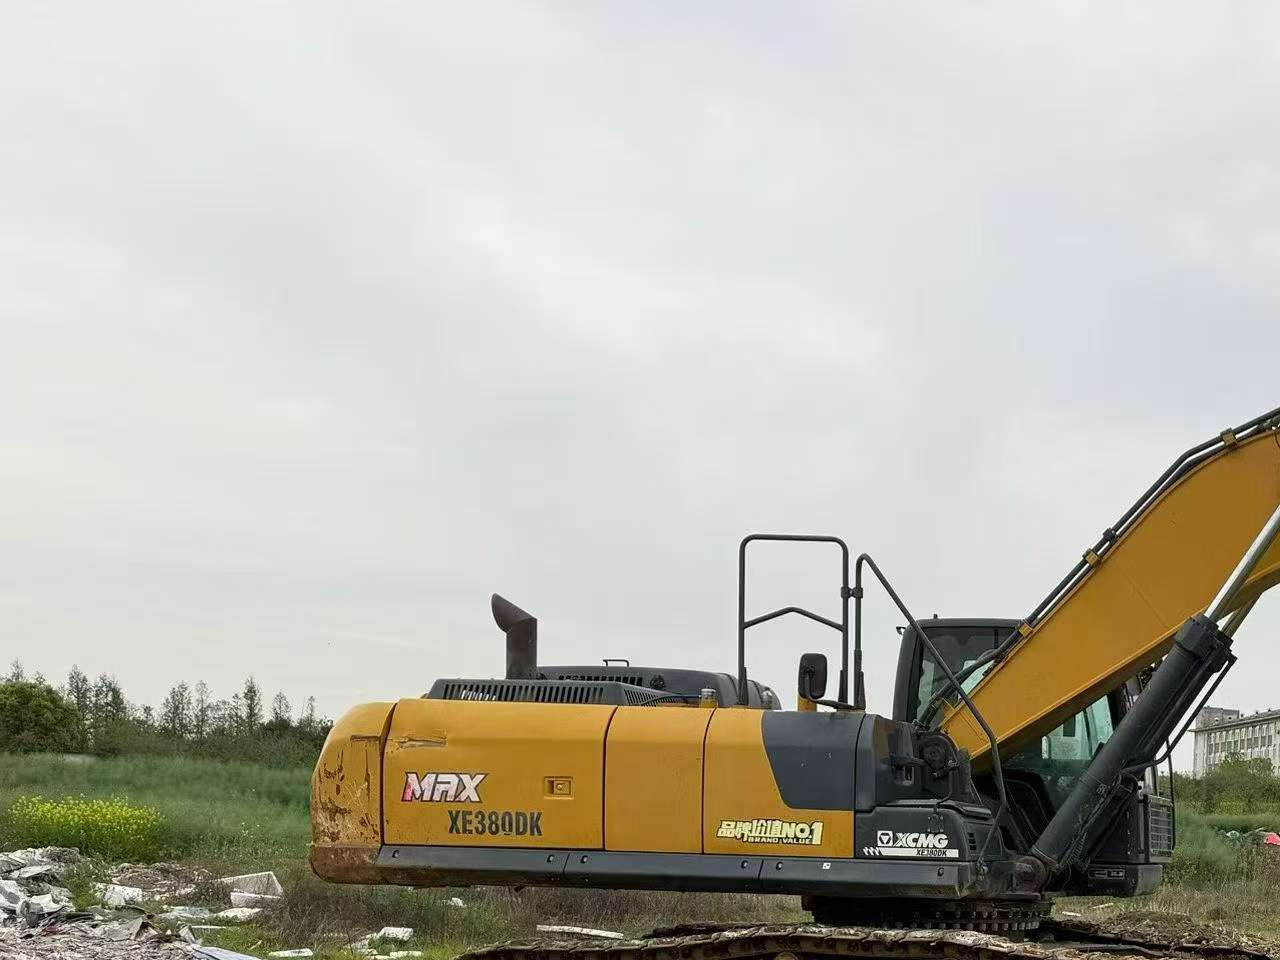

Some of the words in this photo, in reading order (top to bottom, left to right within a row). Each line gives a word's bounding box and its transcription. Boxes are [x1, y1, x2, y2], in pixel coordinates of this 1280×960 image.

[401, 772, 488, 803] MAX
[448, 810, 543, 836] XE380DK
[893, 832, 949, 849] XCMG
